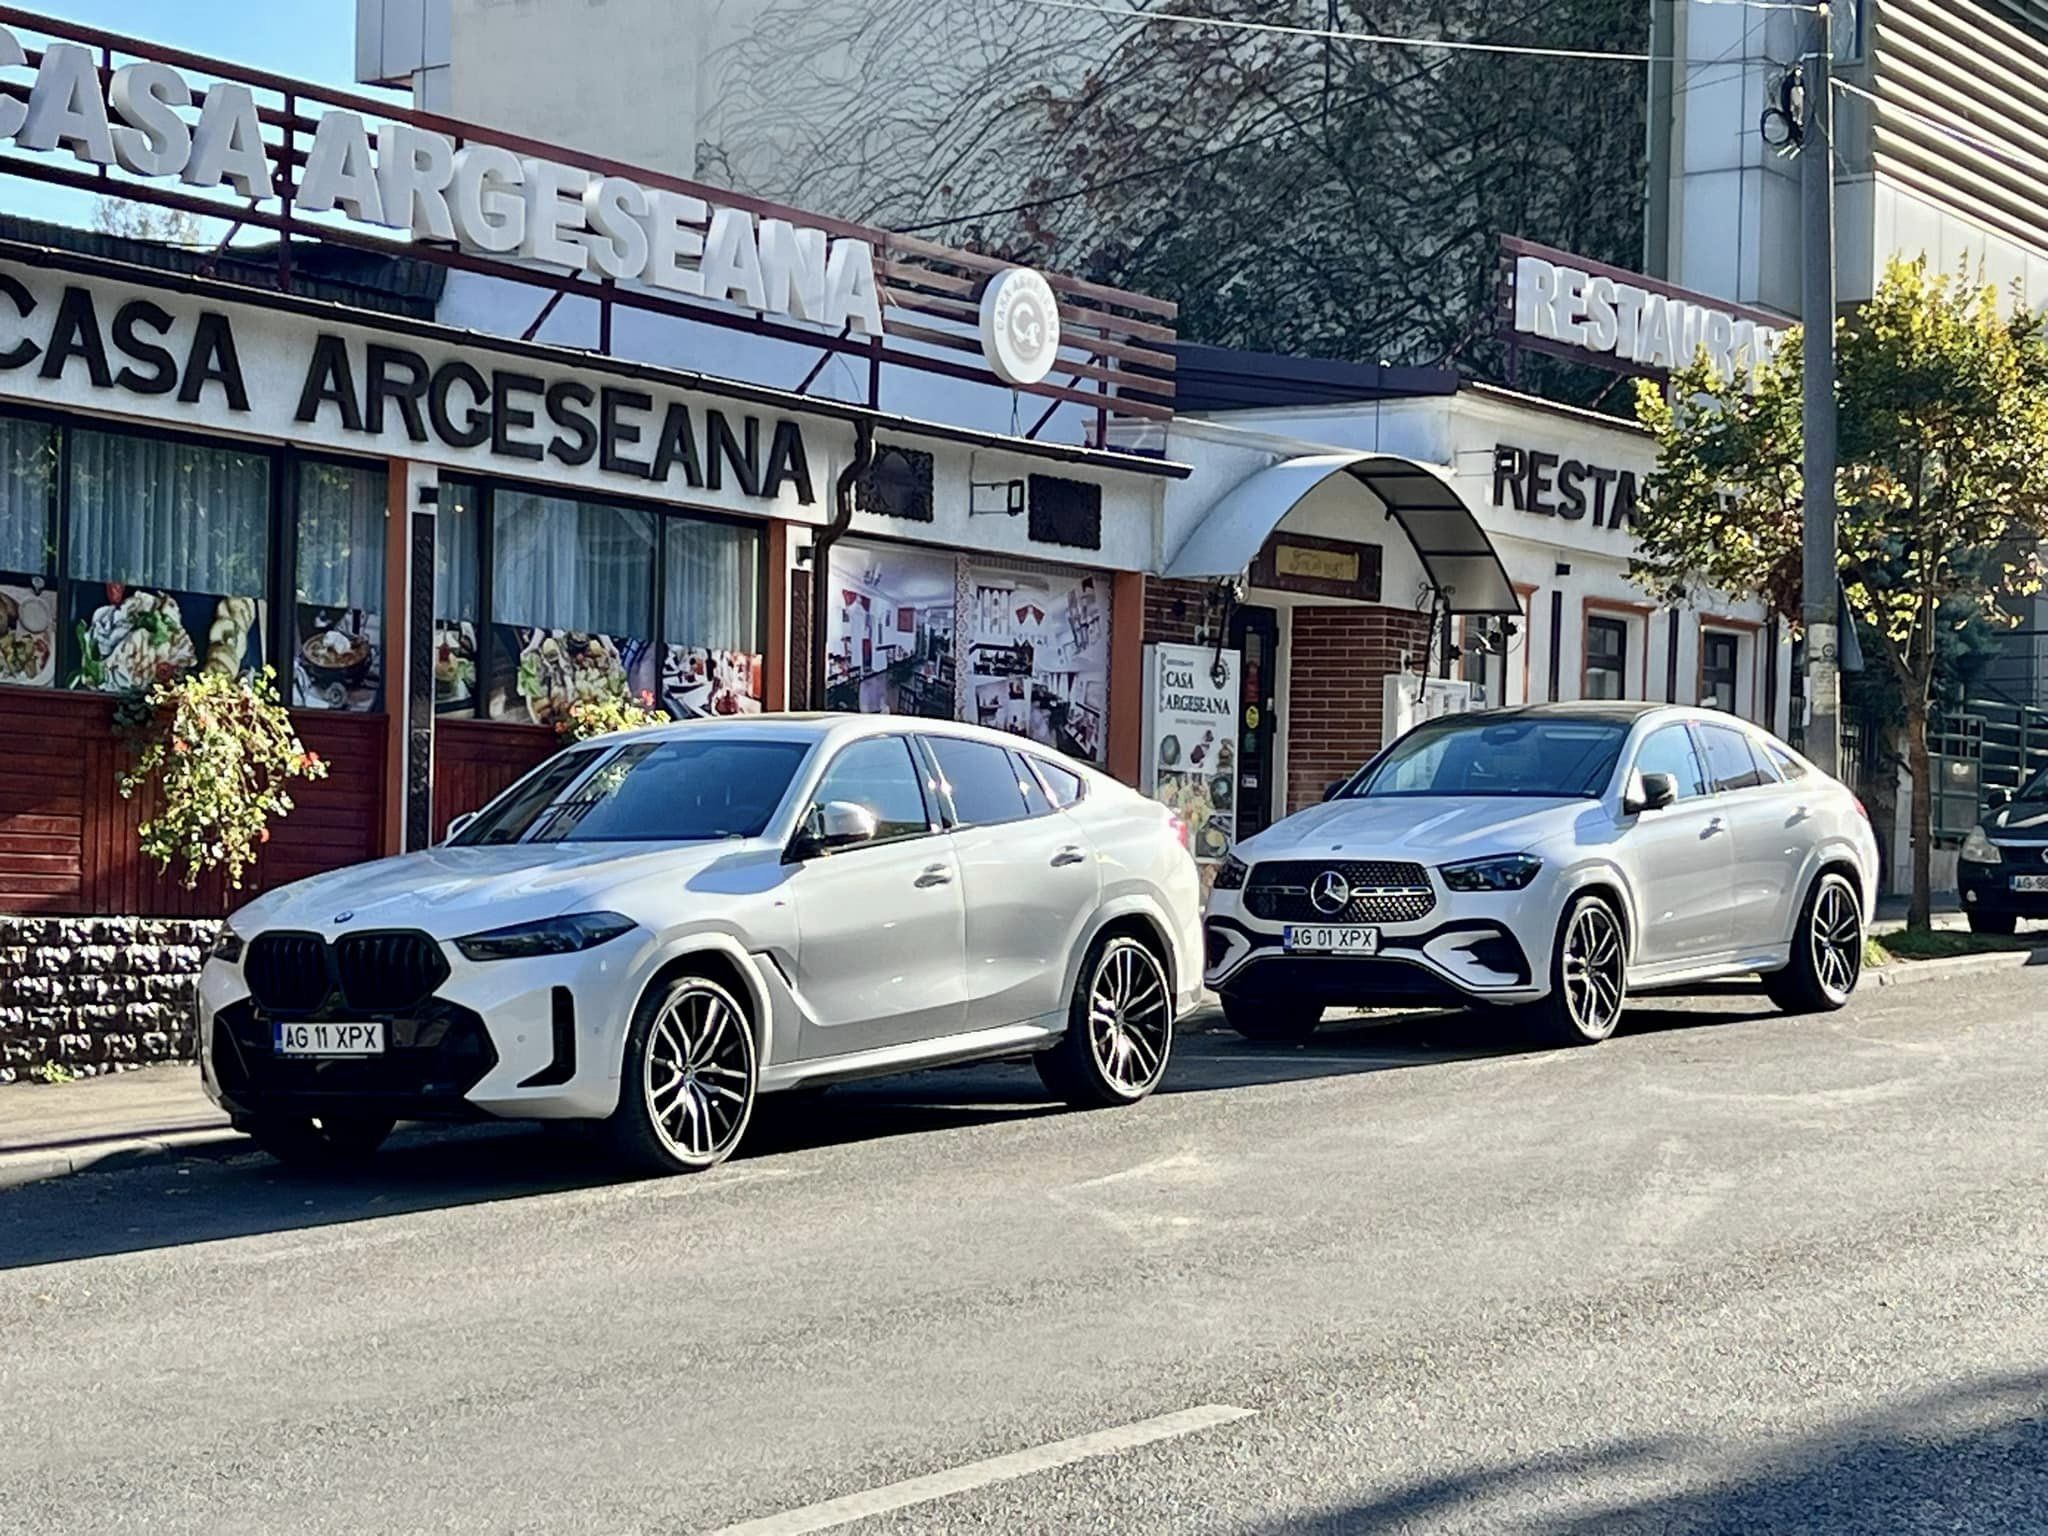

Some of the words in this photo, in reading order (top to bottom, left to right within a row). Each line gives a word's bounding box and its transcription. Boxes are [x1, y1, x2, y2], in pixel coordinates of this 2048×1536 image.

[295, 110, 884, 338] ARGESEANA
[295, 334, 818, 506] ARGESEANA
[1166, 671, 1194, 689] CASA
[1164, 693, 1231, 715] ARGESEANA
[1292, 929, 1312, 946] AG
[1318, 930, 1332, 946] 01
[1339, 930, 1373, 947] XPX
[286, 1026, 308, 1049] AG
[315, 1026, 328, 1049] 11
[336, 1026, 377, 1049] XPX
